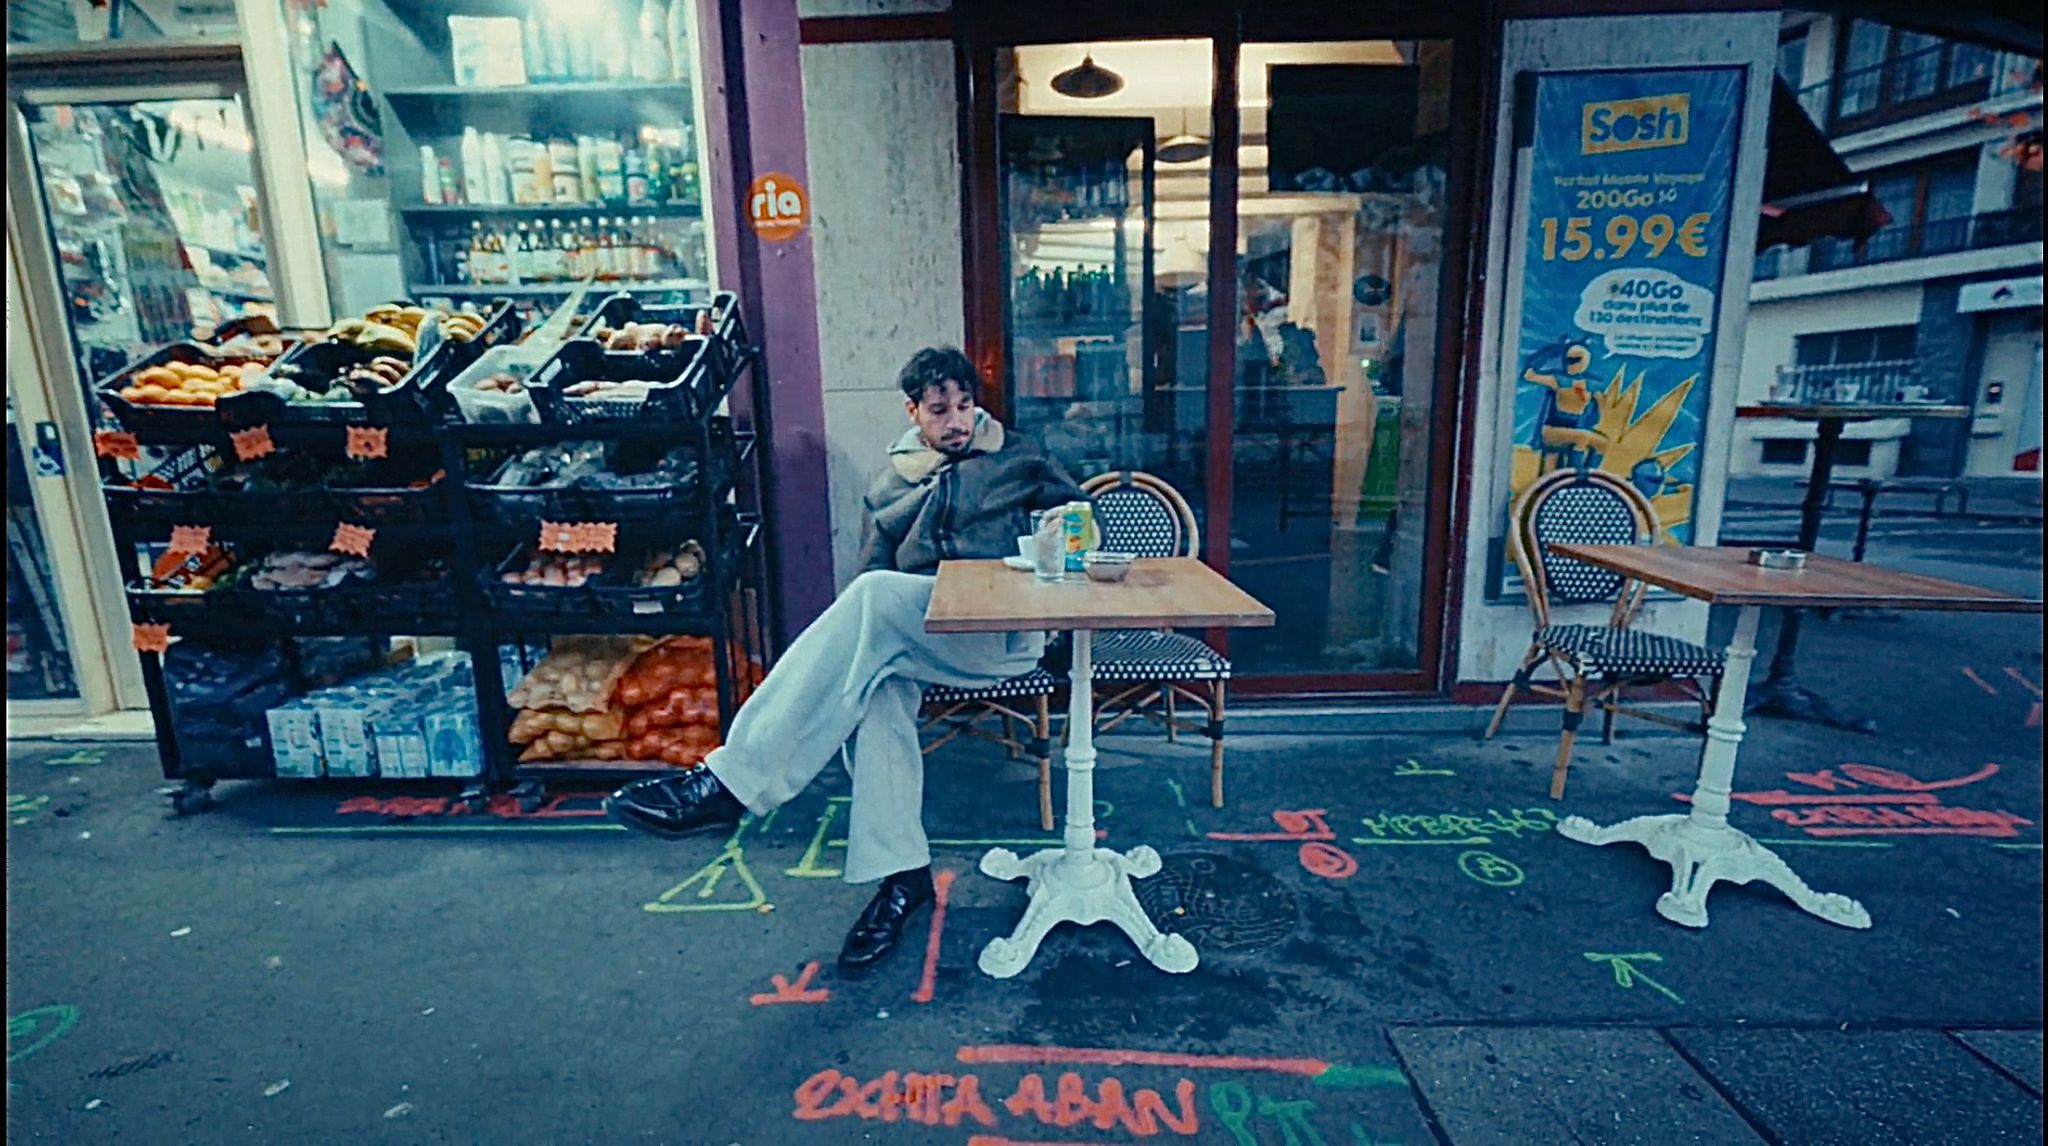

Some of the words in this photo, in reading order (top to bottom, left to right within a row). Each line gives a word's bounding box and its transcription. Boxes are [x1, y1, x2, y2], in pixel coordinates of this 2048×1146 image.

[1589, 106, 1683, 144] Sosh
[751, 179, 801, 218] ria
[1576, 188, 1654, 209] 200Go
[1541, 212, 1712, 261] 15.99€
[1004, 1071, 1198, 1136] ABAN
